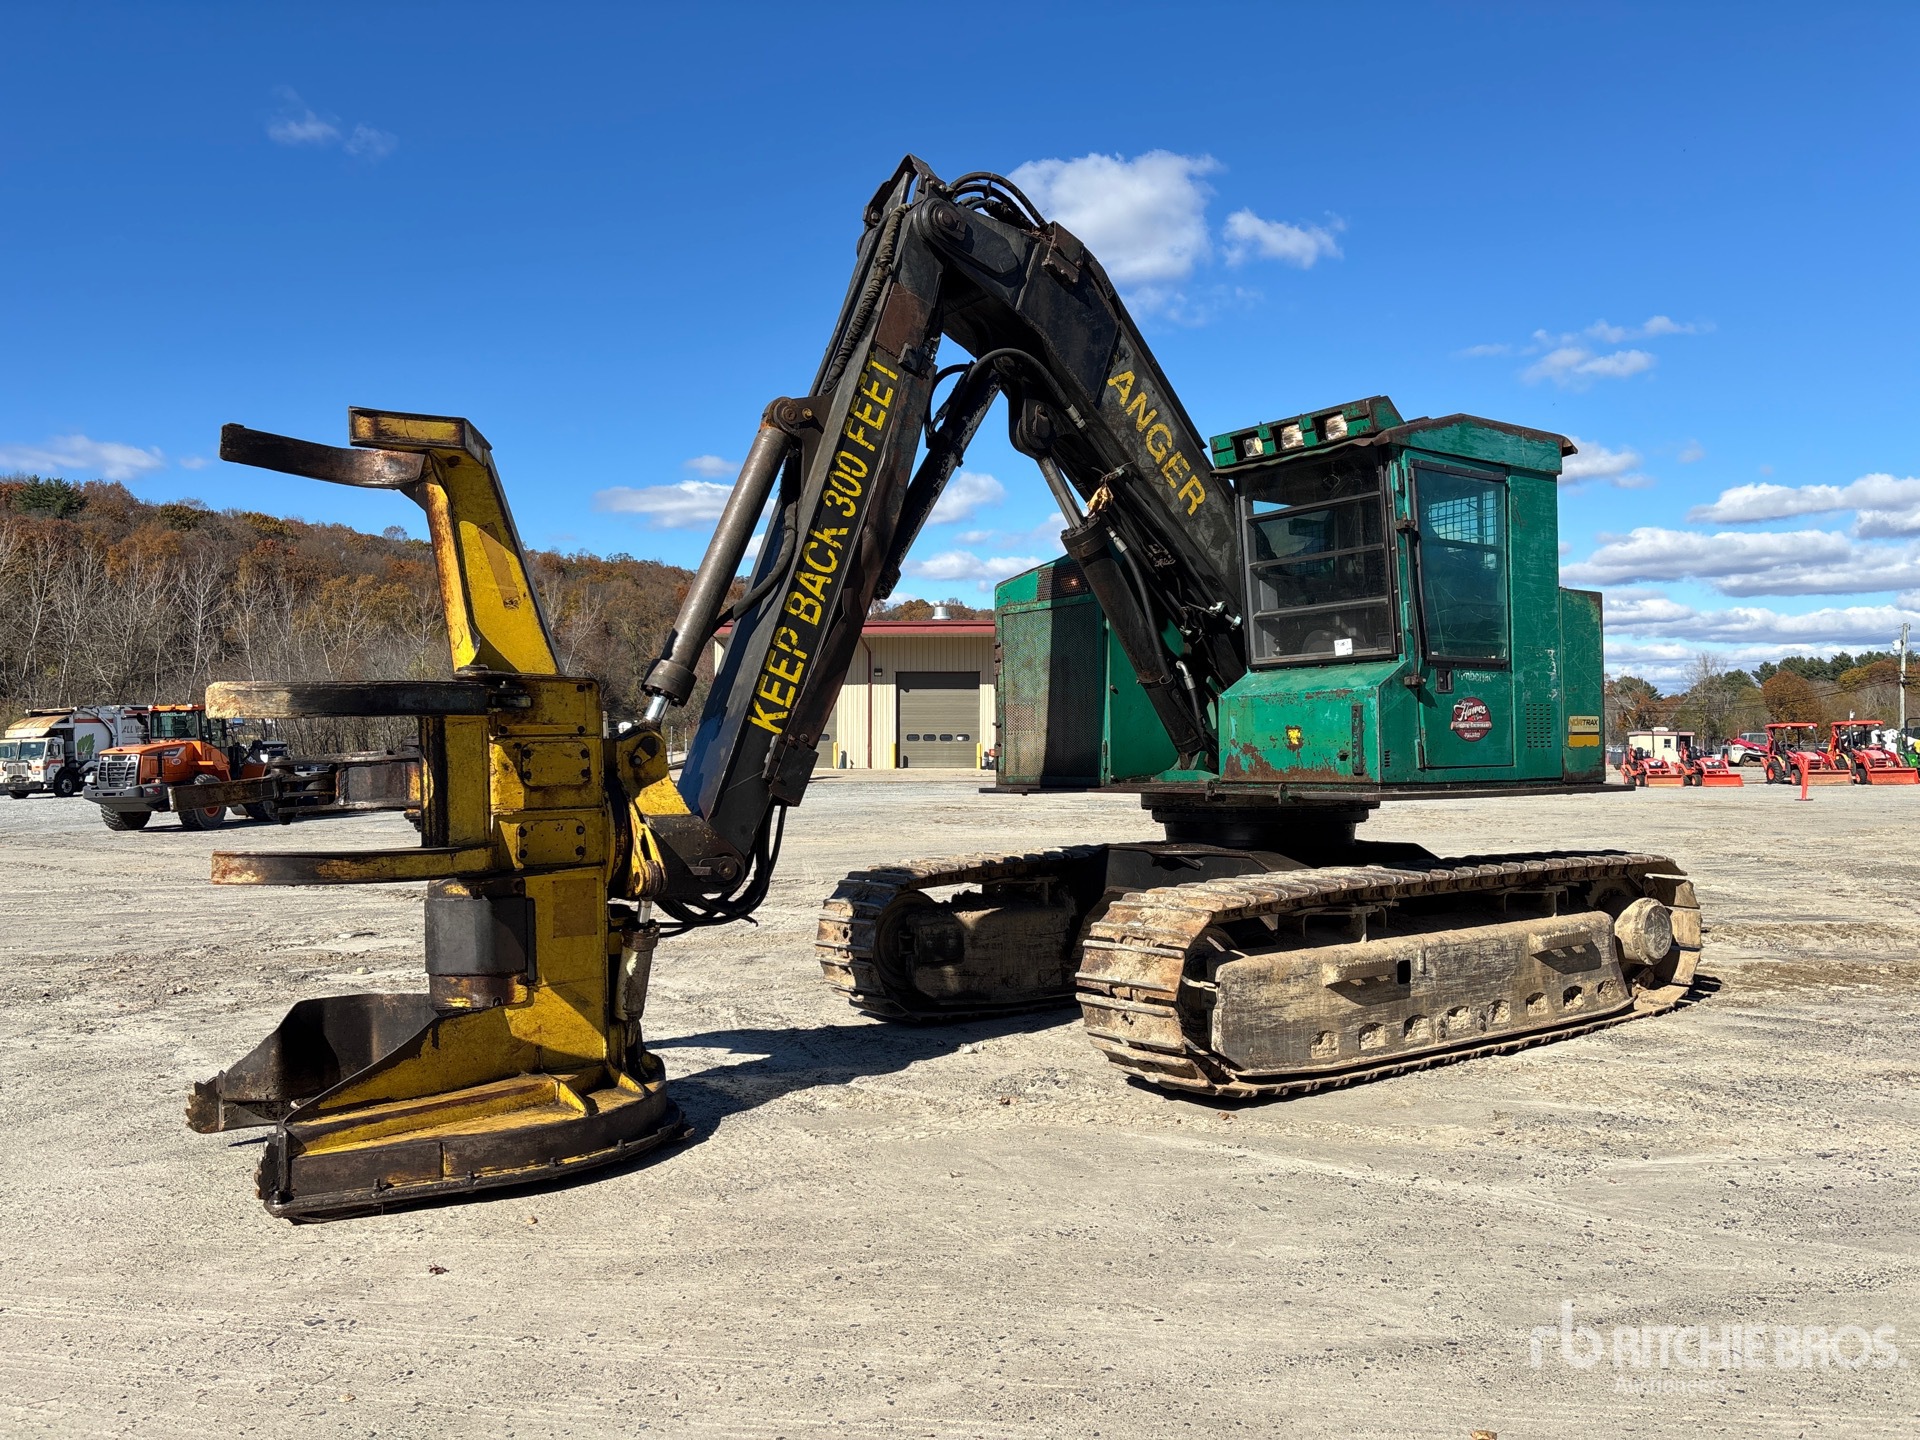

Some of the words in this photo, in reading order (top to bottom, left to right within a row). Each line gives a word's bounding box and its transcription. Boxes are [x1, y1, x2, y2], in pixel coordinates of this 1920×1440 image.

[843, 351, 899, 452] FEET
[823, 450, 869, 518] 300
[784, 526, 850, 627] BACK
[747, 626, 808, 735] KEEP
